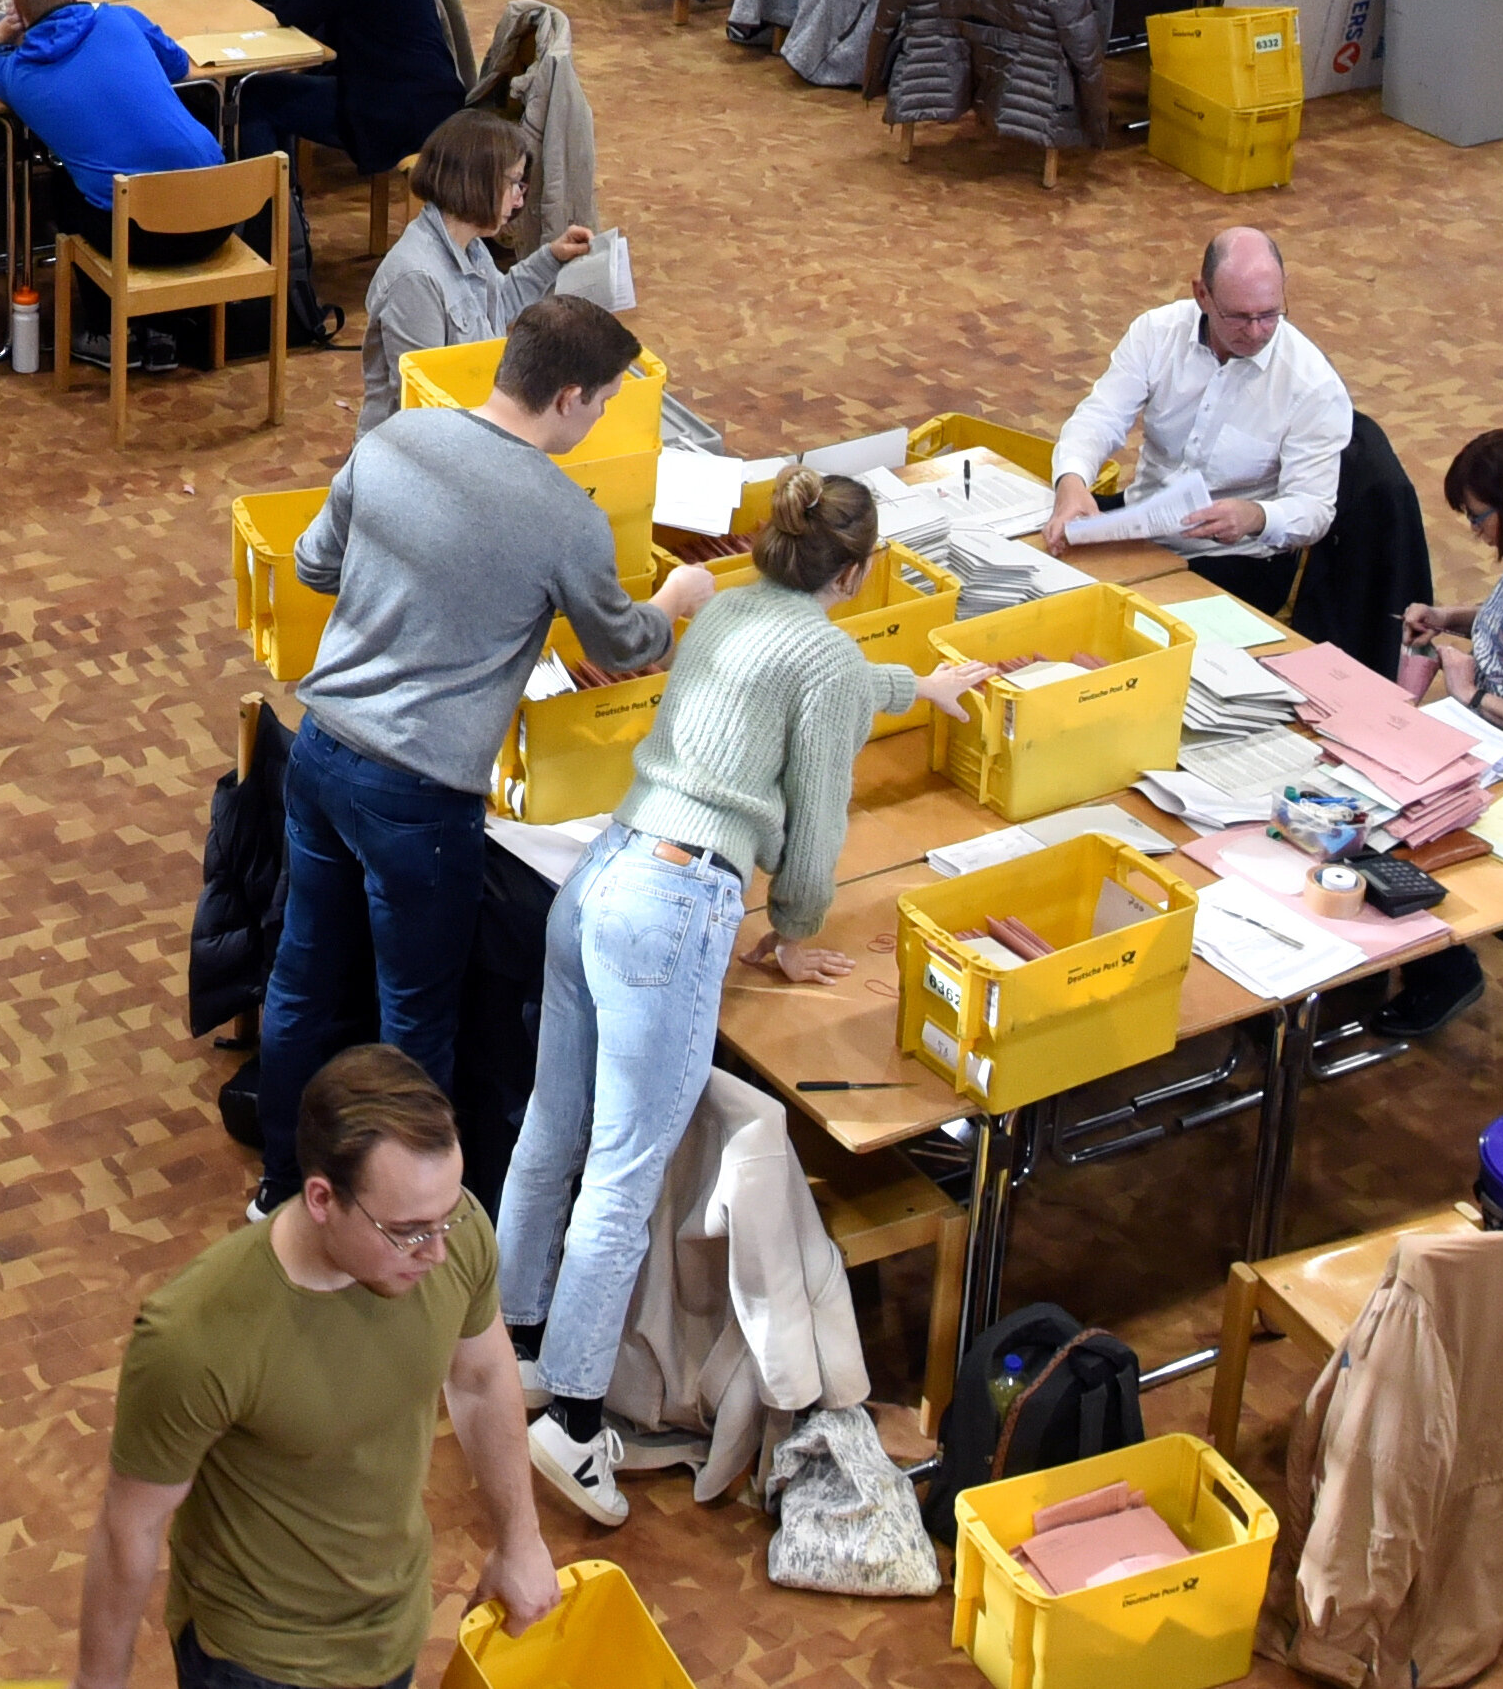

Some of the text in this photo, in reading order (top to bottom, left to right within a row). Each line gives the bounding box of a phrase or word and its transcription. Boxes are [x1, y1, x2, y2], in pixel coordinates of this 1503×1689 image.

[1255, 37, 1280, 51] 6332
[1109, 685, 1124, 696] Post
[594, 699, 648, 719] Deutsche Post
[1066, 960, 1119, 986] Deutsche Post
